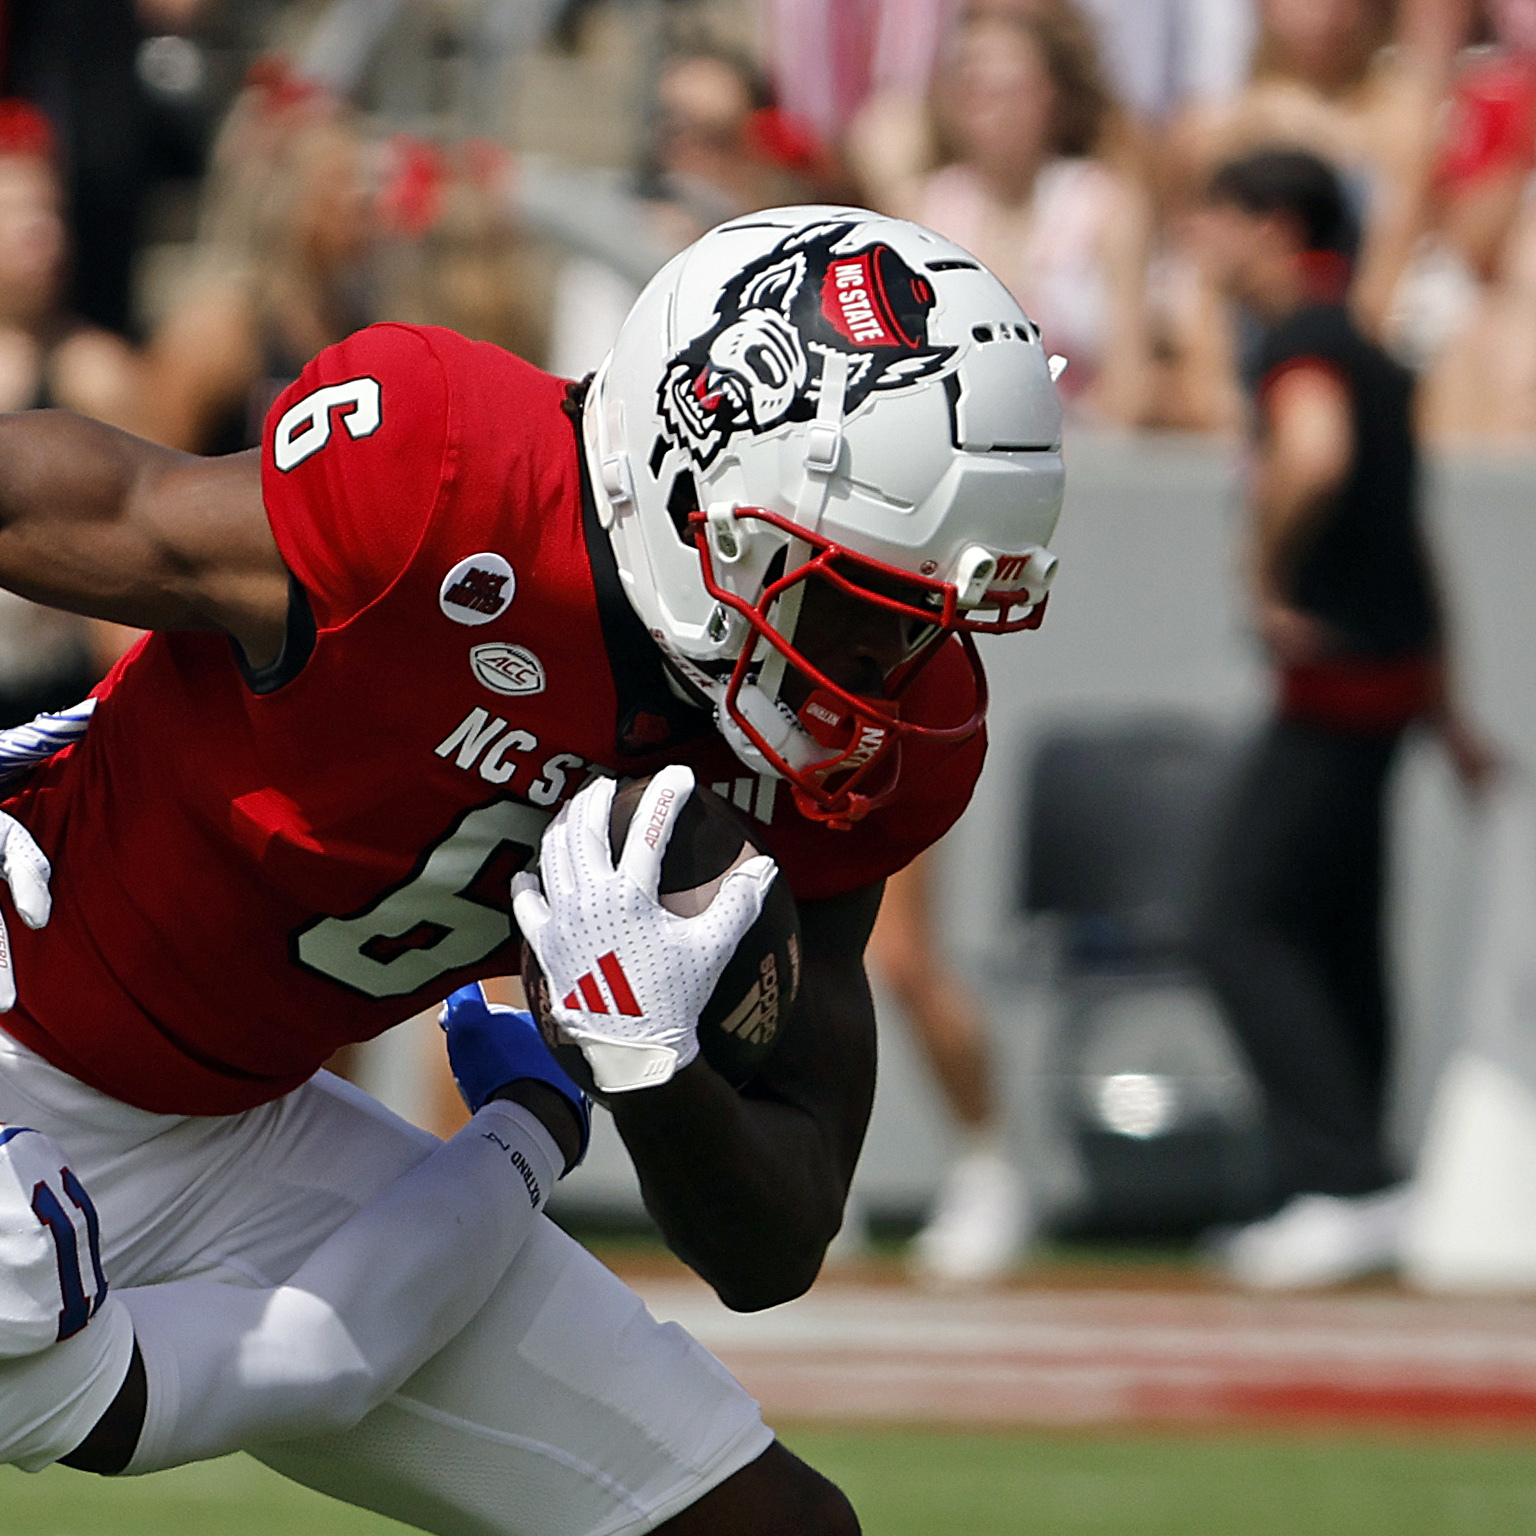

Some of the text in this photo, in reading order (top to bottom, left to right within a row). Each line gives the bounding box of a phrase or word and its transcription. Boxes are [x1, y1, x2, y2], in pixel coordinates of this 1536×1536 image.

[835, 264, 885, 342] NC STATE
[274, 377, 381, 473] 6
[484, 656, 538, 684] ACC
[434, 706, 538, 784] NC
[644, 788, 676, 850] ADIZERO
[289, 798, 538, 1000] 6
[31, 1166, 109, 1342] 11
